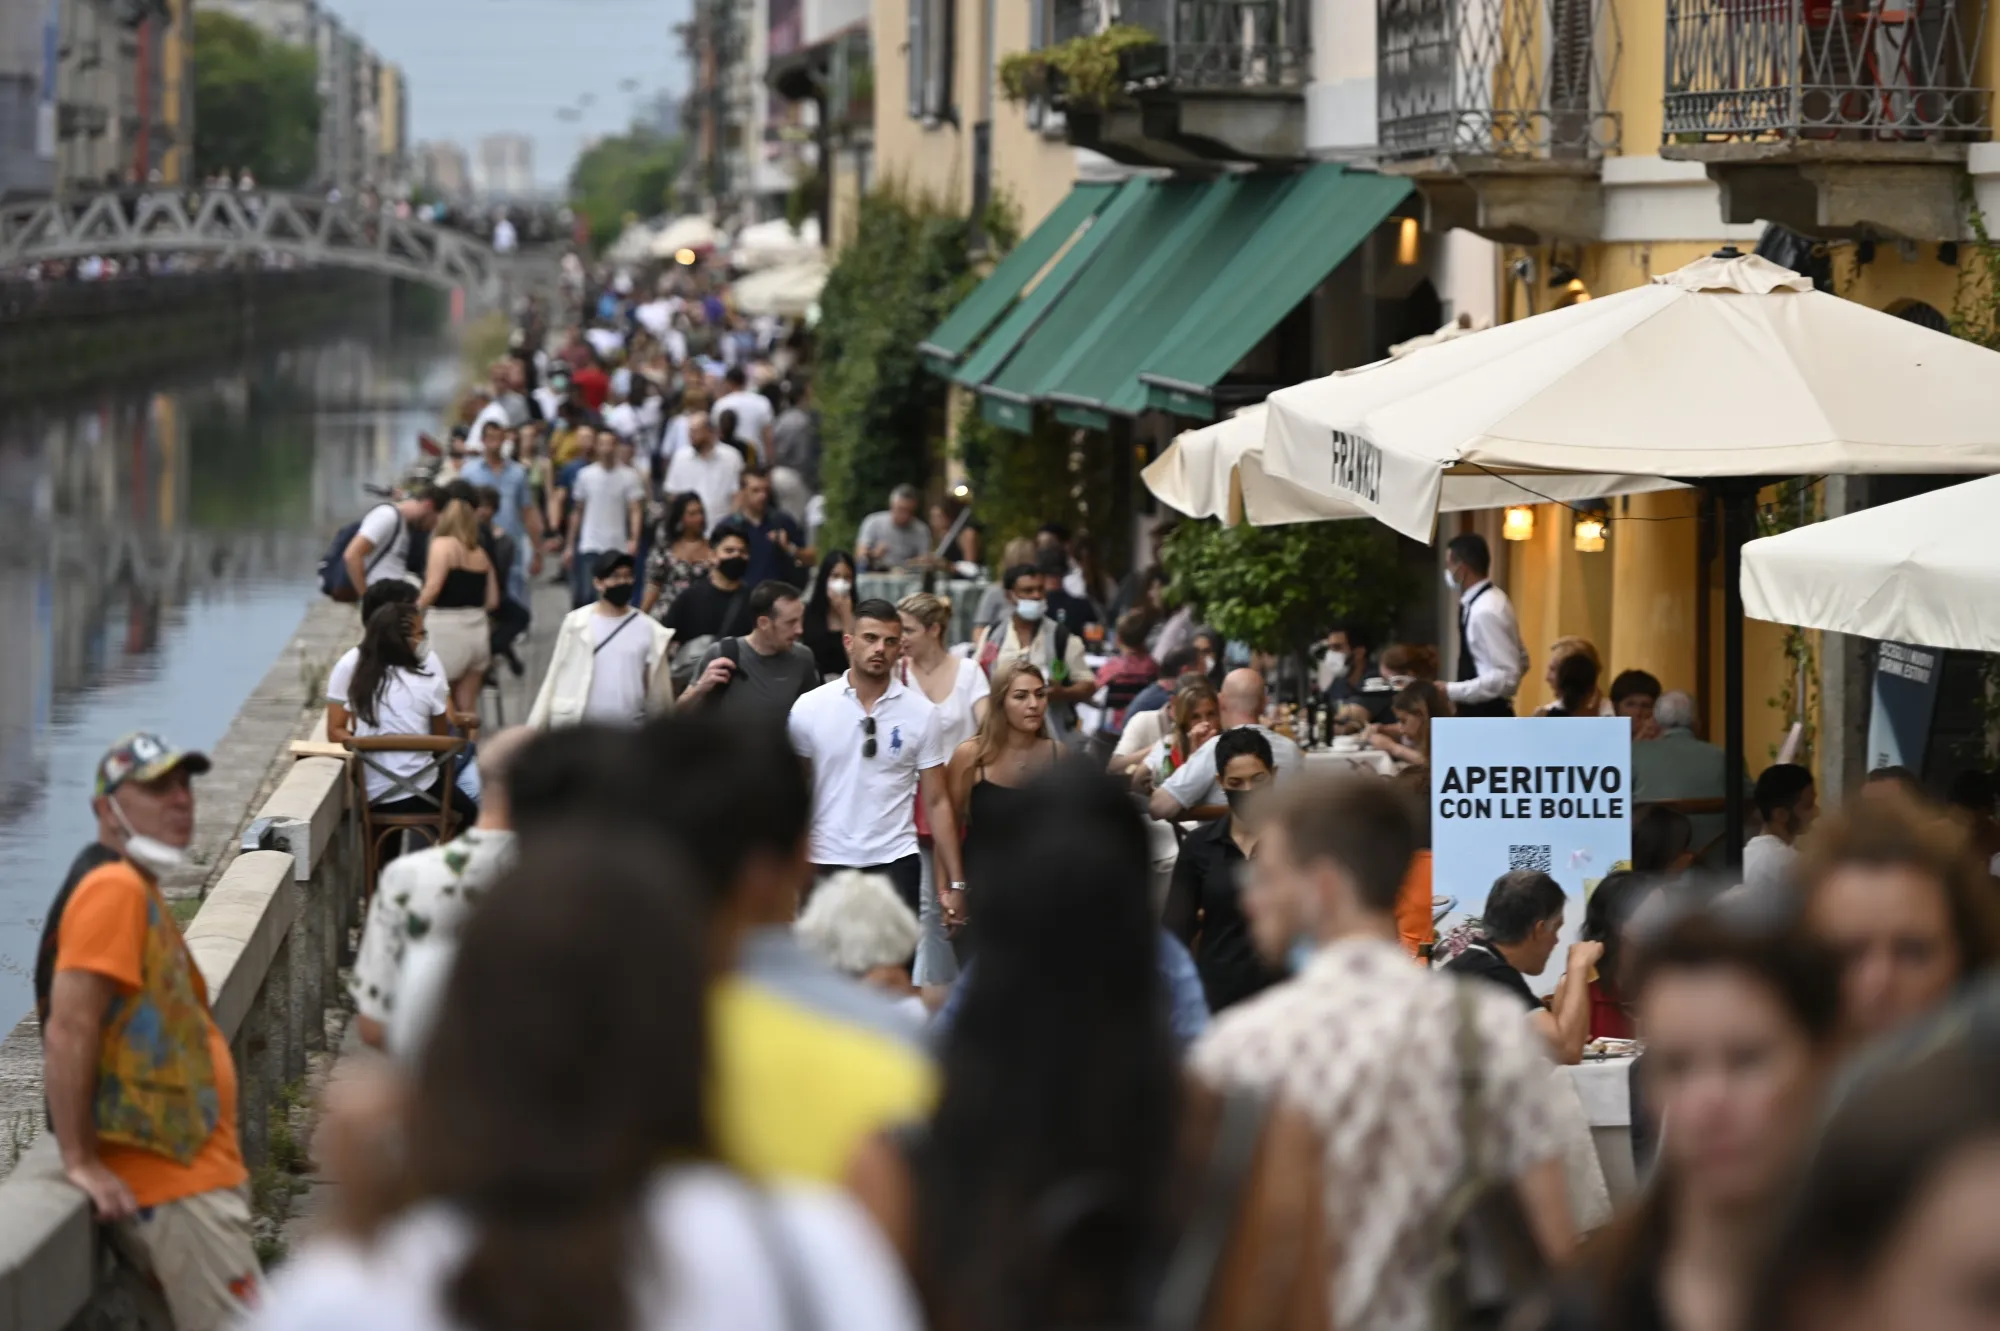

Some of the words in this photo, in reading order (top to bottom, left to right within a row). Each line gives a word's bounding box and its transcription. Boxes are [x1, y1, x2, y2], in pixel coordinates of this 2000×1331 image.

[1331, 429, 1382, 505] FRANKLY
[1440, 766, 1621, 794] APERITIVO
[1440, 798, 1491, 819] CON
[1501, 798, 1531, 819] LE
[1540, 798, 1624, 819] BOLLE
